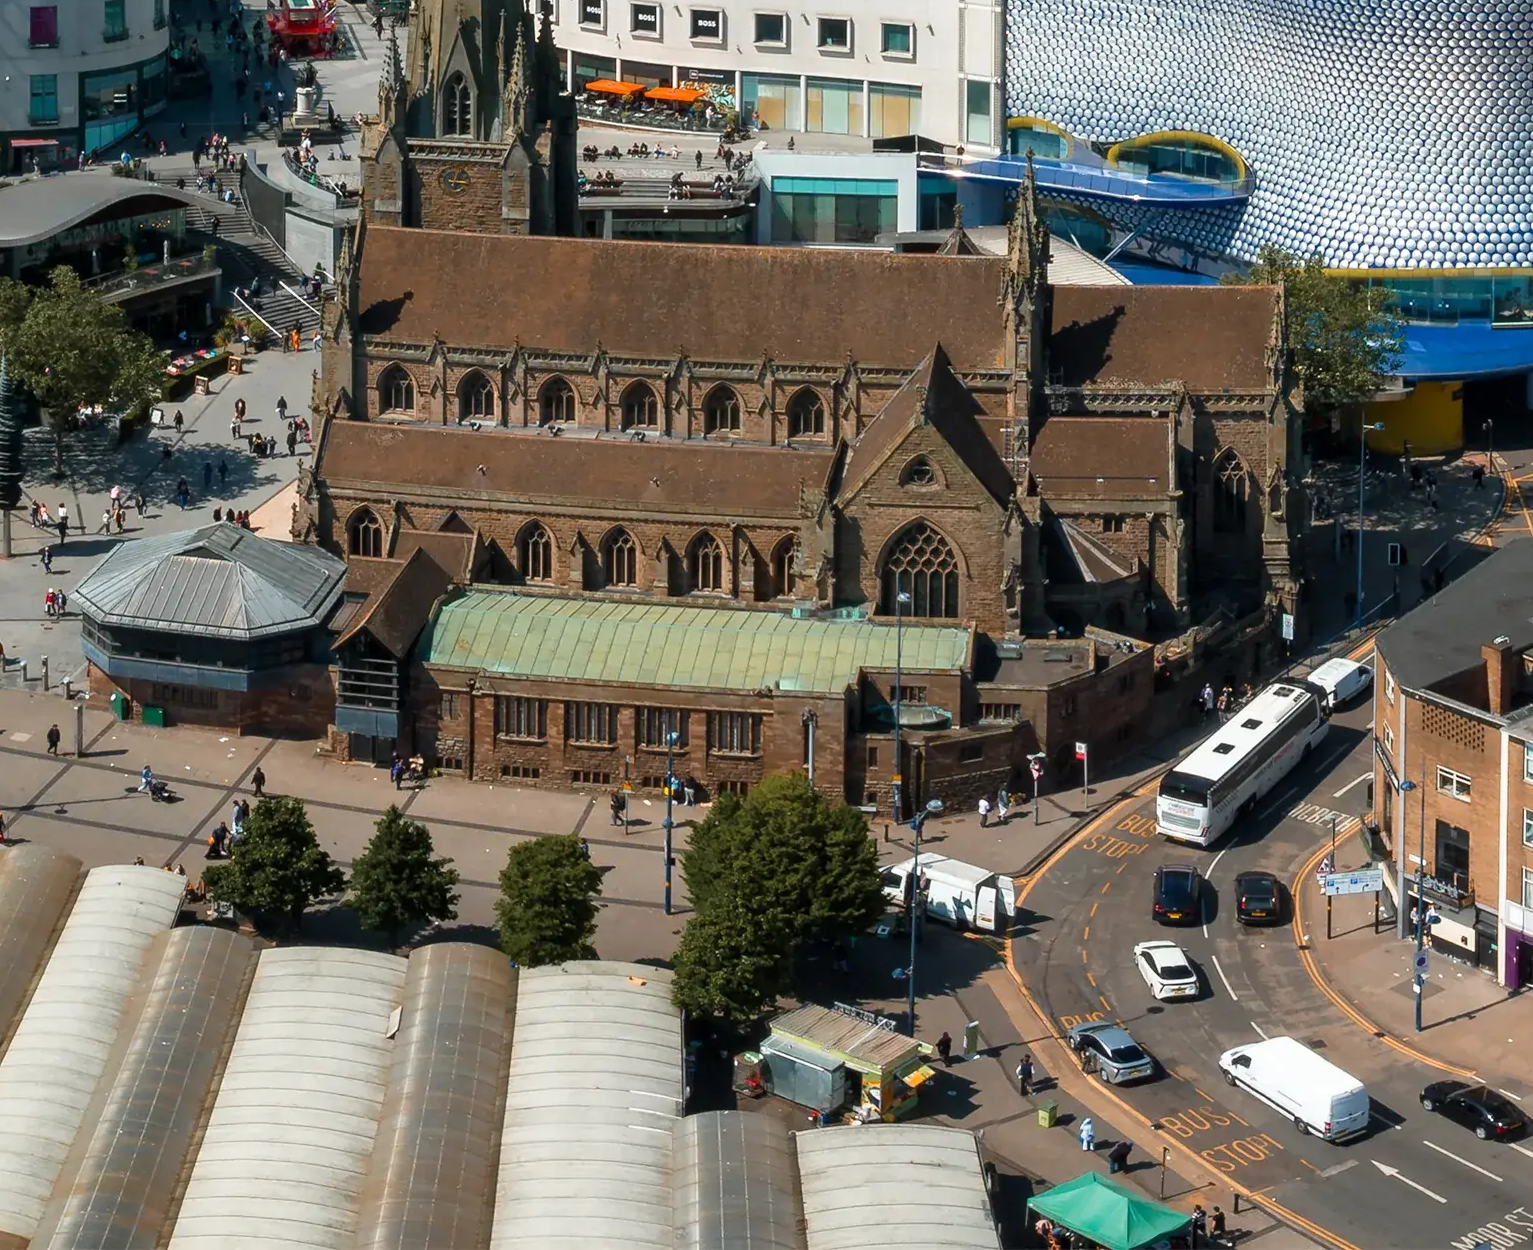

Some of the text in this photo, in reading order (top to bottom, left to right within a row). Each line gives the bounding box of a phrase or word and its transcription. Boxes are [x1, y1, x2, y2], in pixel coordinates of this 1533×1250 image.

[638, 13, 656, 23] BOSS
[697, 19, 717, 28] BOSS
[1116, 813, 1158, 840] BUS
[1158, 1105, 1231, 1139] BUS
[1200, 1133, 1273, 1172] STOP
